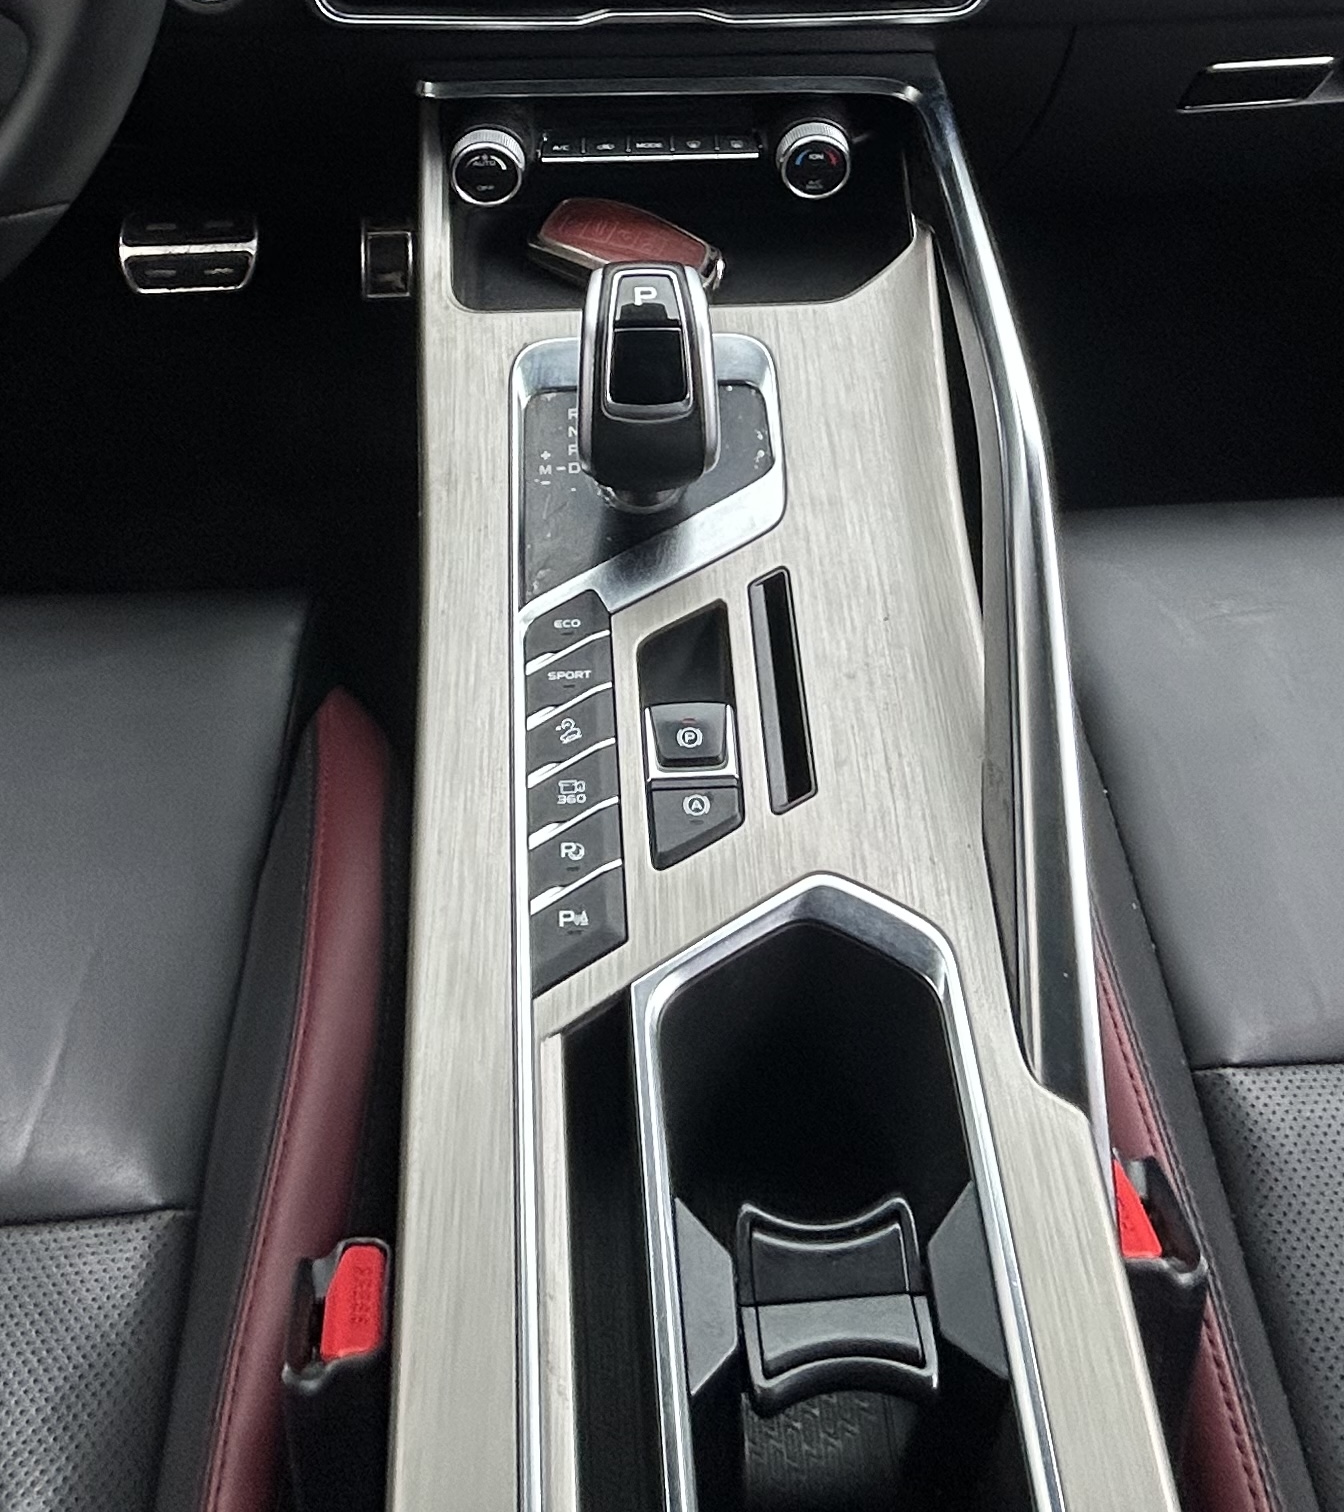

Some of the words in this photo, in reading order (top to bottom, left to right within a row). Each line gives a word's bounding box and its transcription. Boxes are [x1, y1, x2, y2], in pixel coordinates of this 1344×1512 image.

[635, 141, 664, 150] MODE
[472, 159, 497, 168] AUTO
[633, 286, 658, 307] P
[553, 618, 582, 630] ECO
[547, 669, 592, 682] SPORT
[556, 793, 587, 805] 360
